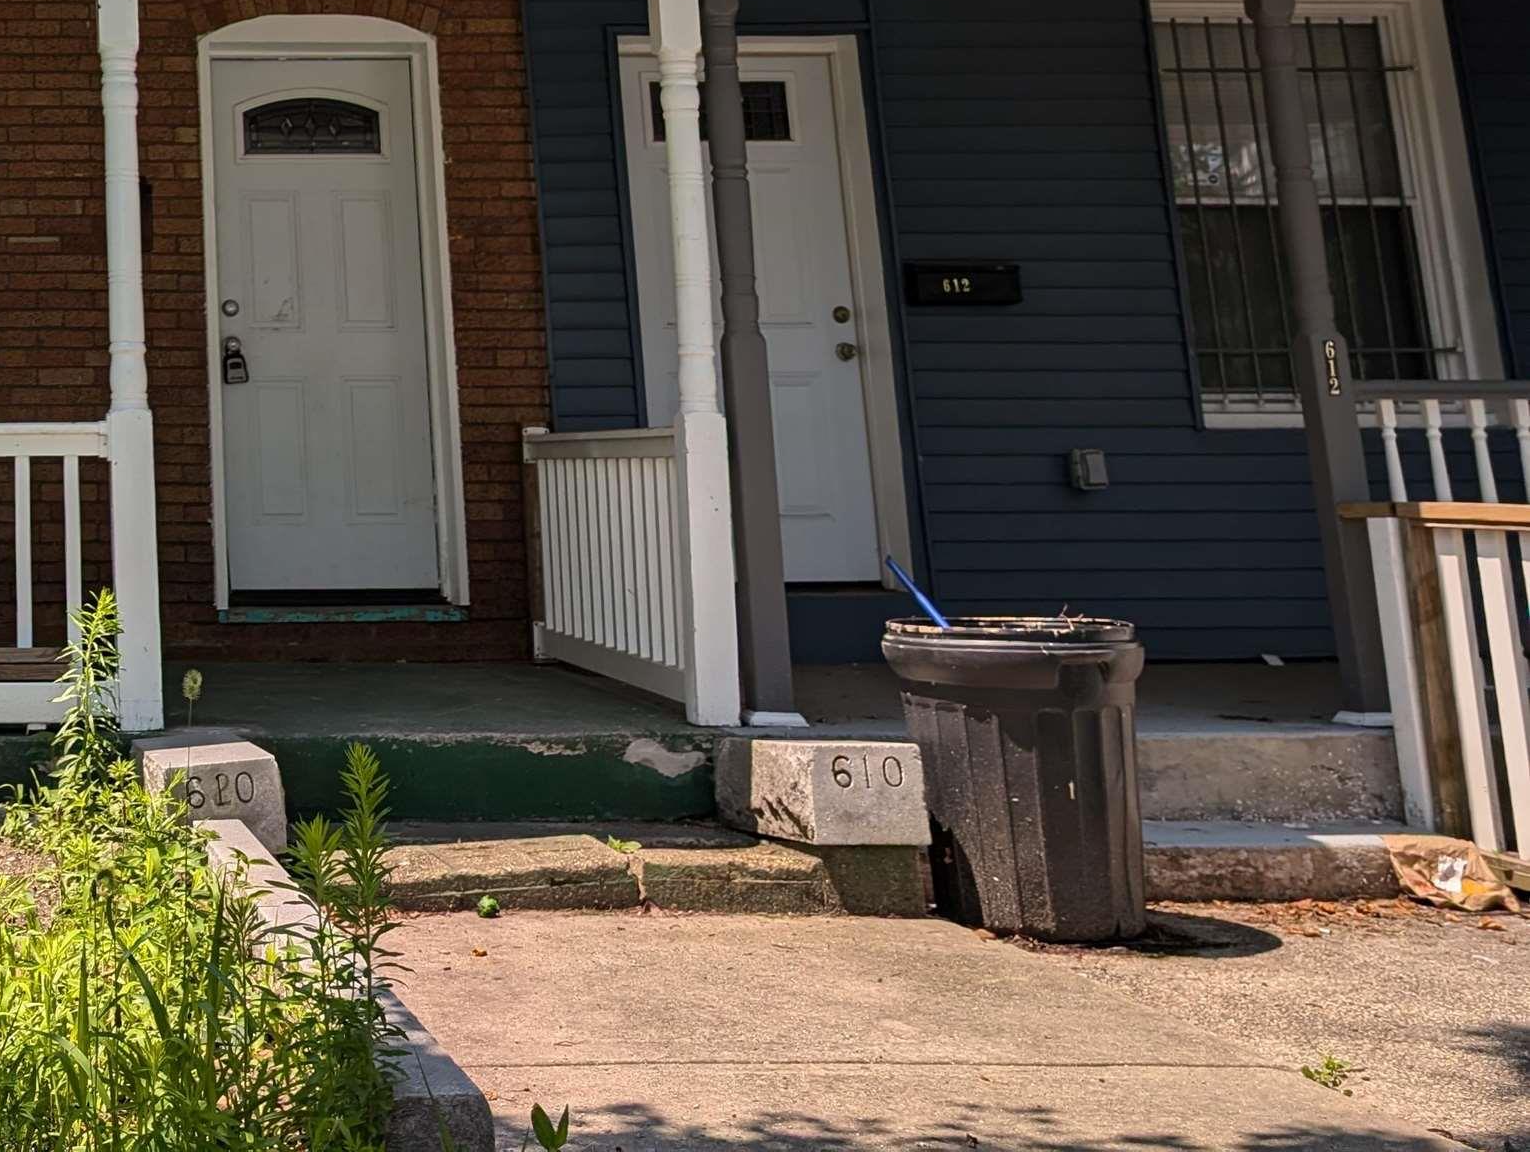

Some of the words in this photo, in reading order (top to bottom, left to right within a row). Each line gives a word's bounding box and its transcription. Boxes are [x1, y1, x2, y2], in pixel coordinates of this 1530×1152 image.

[943, 277, 970, 293] 612
[1325, 340, 1340, 395] 612
[831, 753, 904, 790] 610
